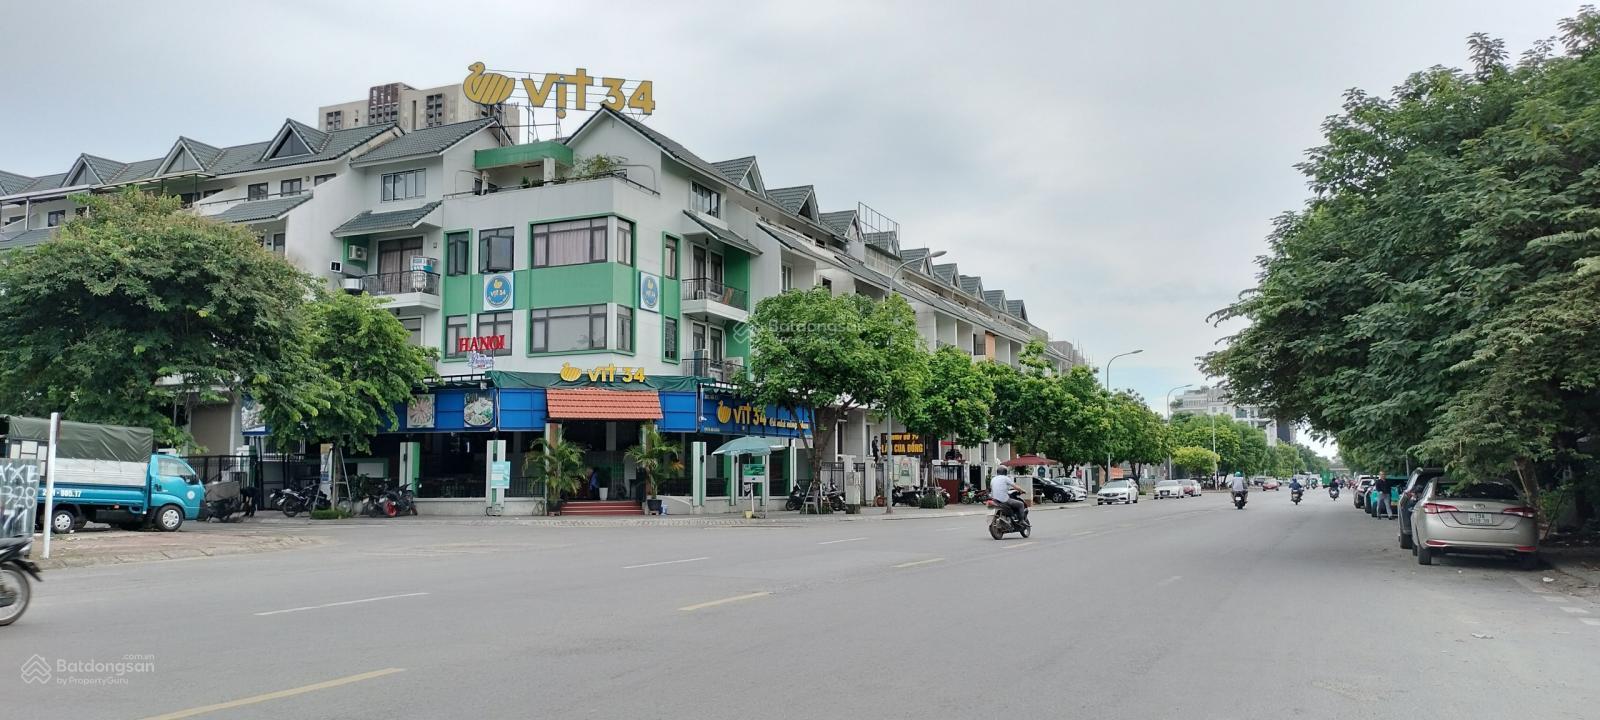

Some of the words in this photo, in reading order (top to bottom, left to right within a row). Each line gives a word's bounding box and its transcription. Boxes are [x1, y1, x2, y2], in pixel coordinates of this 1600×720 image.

[600, 77, 655, 116] 34
[458, 334, 505, 352] HANOI
[622, 367, 645, 383] 34
[753, 406, 767, 426] 34
